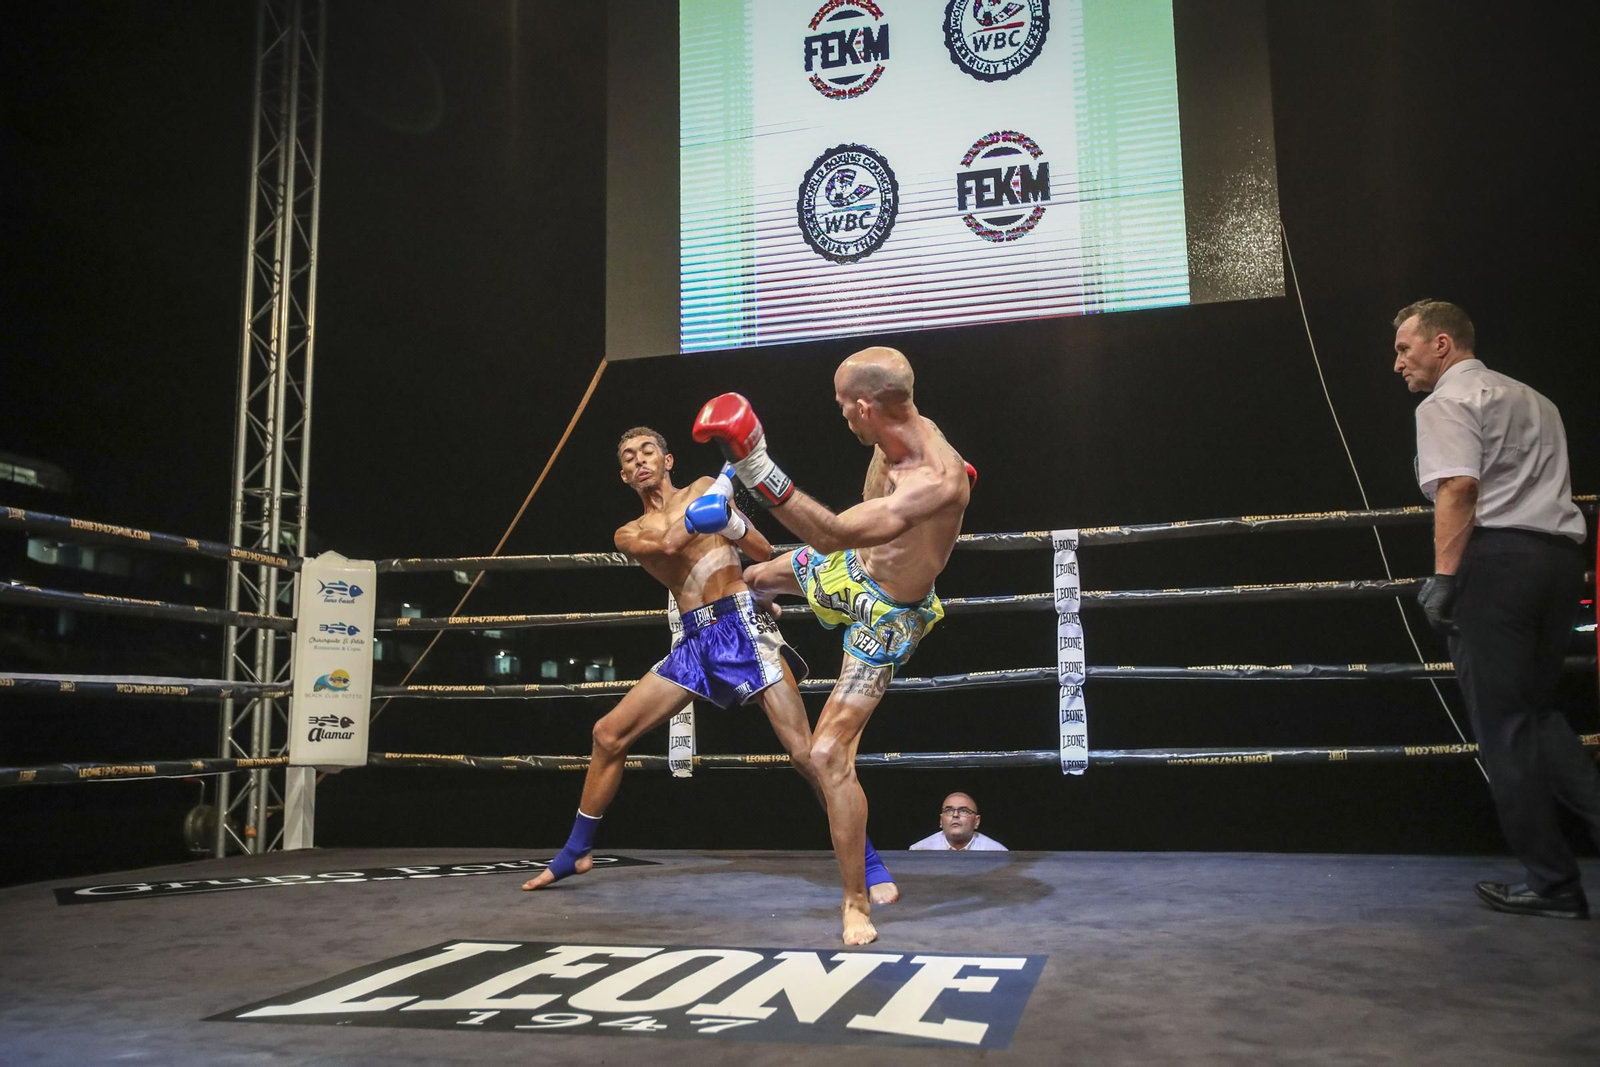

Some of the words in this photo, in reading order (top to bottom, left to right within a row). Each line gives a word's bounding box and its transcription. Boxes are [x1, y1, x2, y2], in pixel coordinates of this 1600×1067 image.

[972, 30, 1021, 53] WBC
[965, 56, 1000, 75] MUAY
[1002, 45, 1033, 72] THAI
[825, 211, 872, 234] WBC
[1055, 562, 1077, 578] LEONE
[1056, 587, 1079, 602] LEONE
[693, 605, 717, 627] LEONE
[854, 632, 881, 656] PEPI
[1059, 637, 1083, 651] LEONE
[1060, 661, 1084, 676] LEONE
[671, 712, 692, 727] LEONE
[1061, 709, 1085, 724] LEONE
[670, 735, 692, 750] LEONE
[1062, 735, 1086, 749] LEONE
[74, 871, 366, 896] Grupo
[387, 857, 619, 875] Potio
[235, 942, 1029, 1046] LEONE
[456, 1010, 763, 1034] 1947
